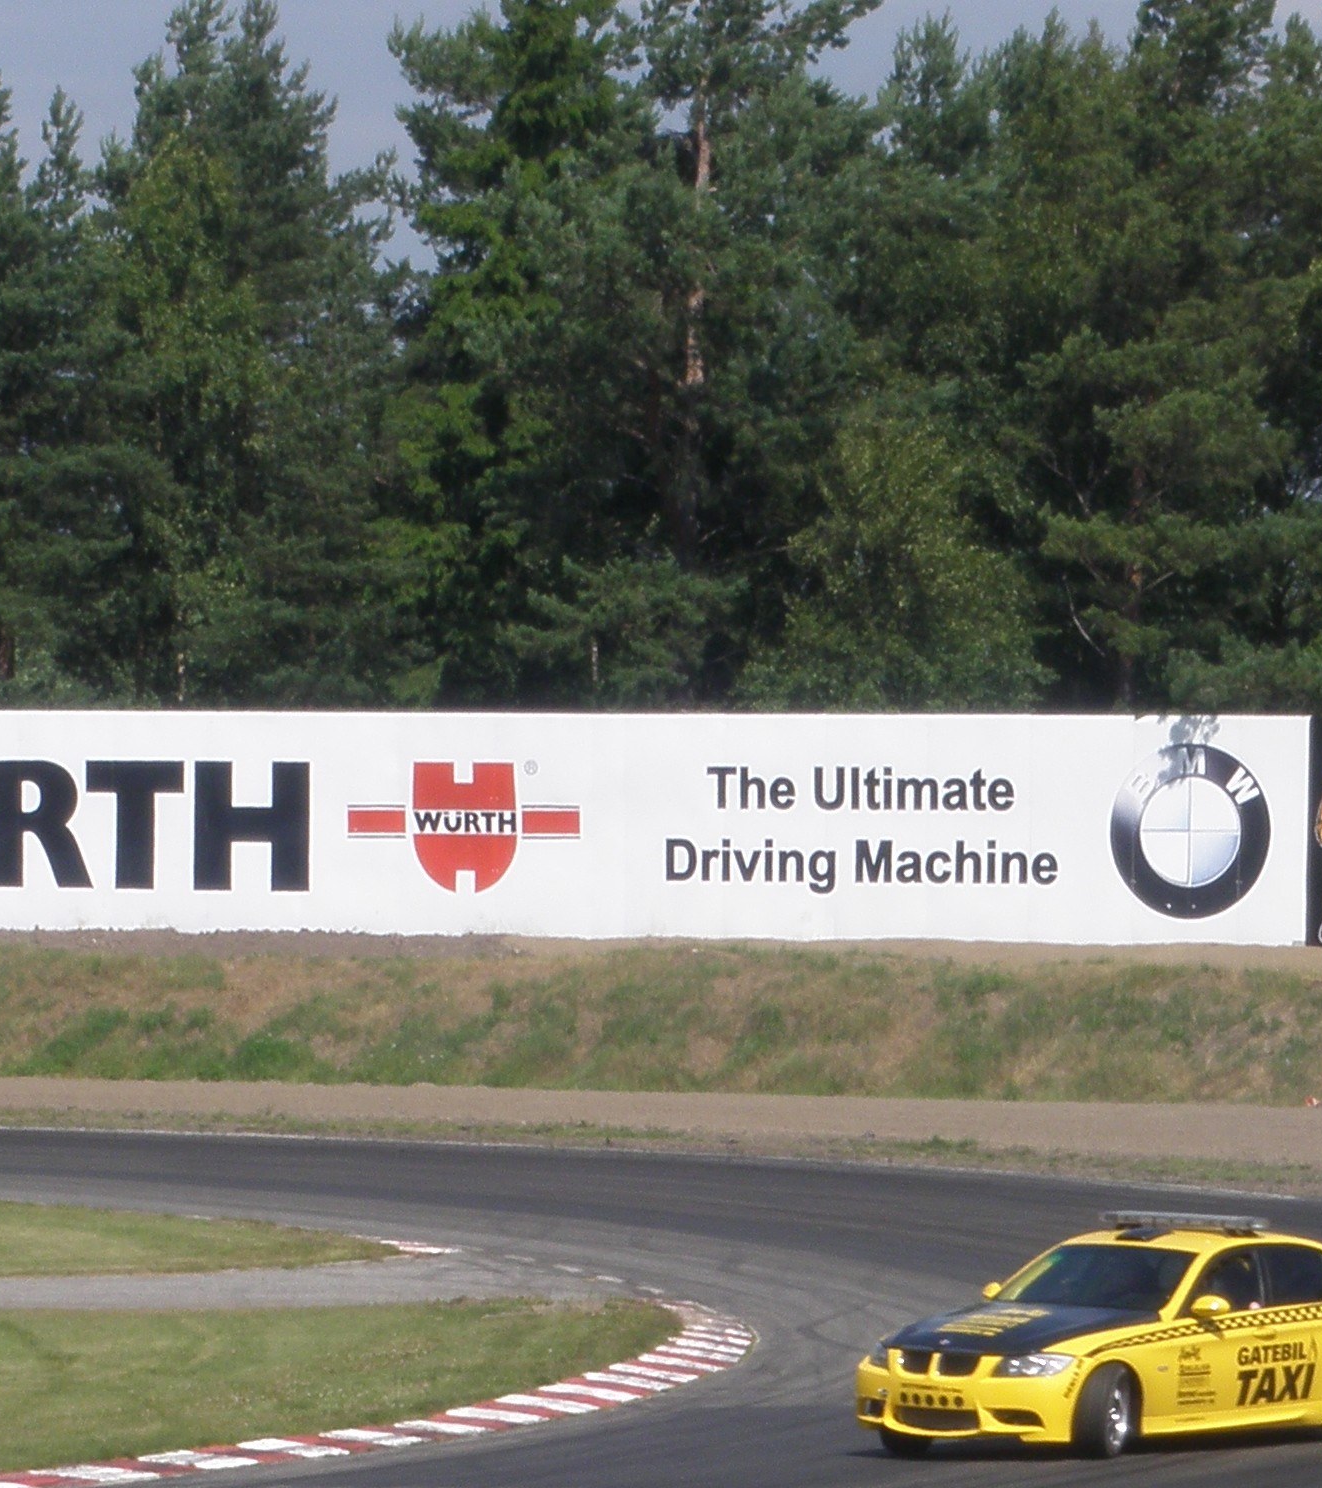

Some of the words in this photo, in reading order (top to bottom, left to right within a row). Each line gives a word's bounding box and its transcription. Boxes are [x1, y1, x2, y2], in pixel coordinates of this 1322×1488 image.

[707, 766, 795, 810] The
[814, 767, 1015, 811] Ultimate
[414, 811, 516, 833] WÜRTH
[665, 839, 837, 894] Driving
[855, 839, 1058, 885] Machine
[1238, 1342, 1307, 1366] GATEBIL
[1236, 1363, 1317, 1407] TAXI
